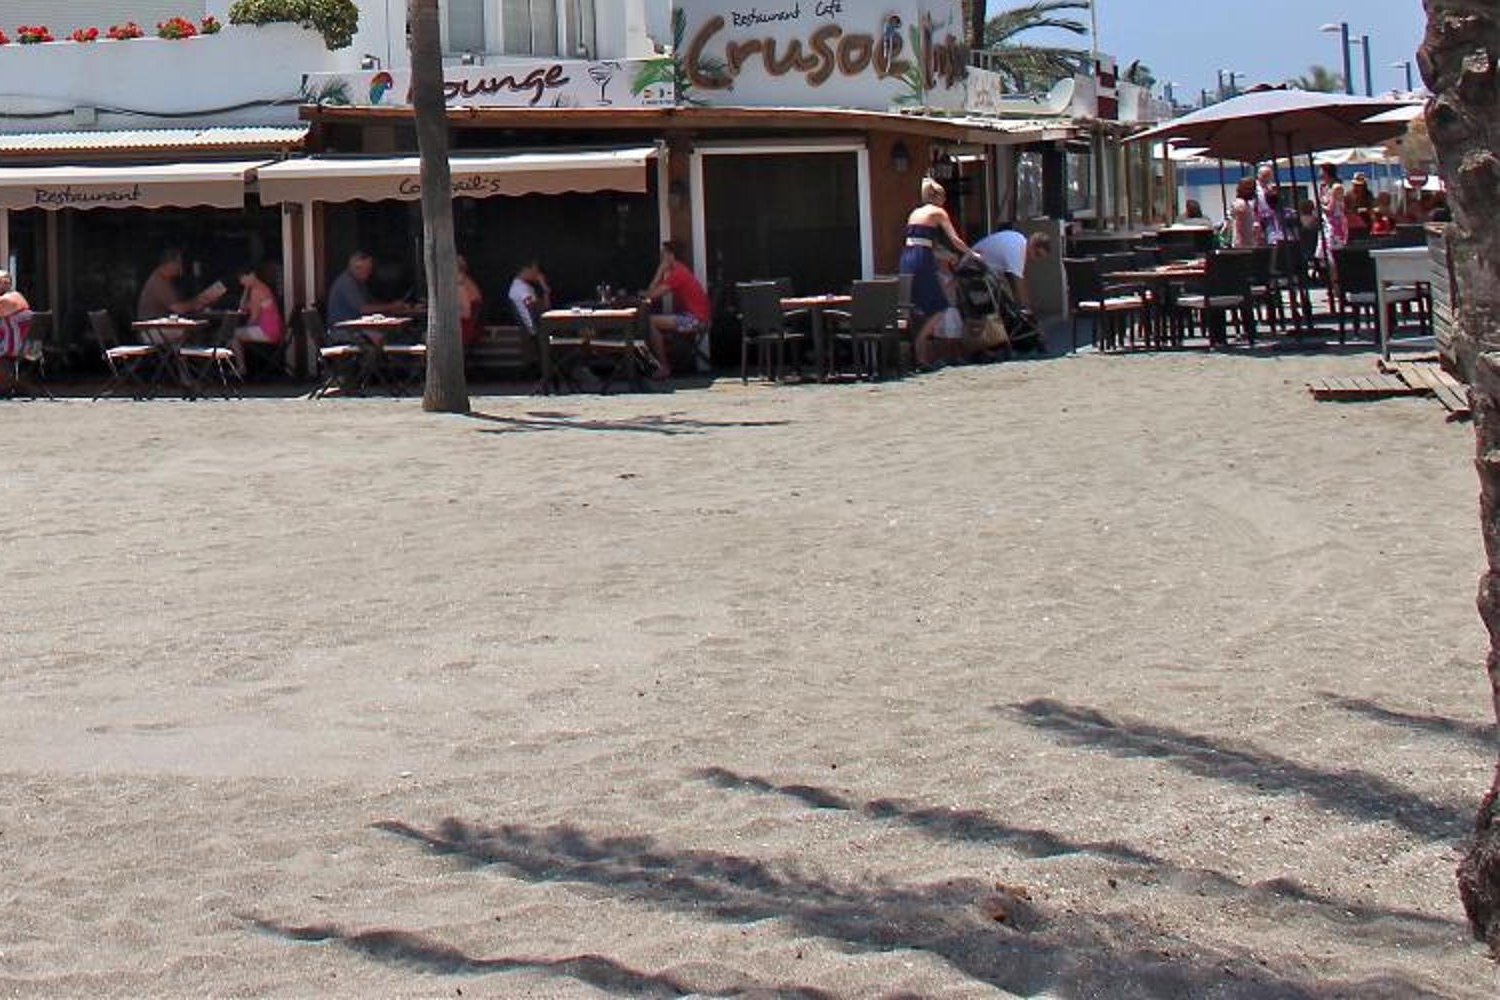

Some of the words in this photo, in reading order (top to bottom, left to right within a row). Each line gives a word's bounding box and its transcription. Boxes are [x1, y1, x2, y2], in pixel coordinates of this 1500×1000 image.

[732, 1, 801, 28] Restaurant
[406, 63, 570, 106] ounge
[34, 183, 140, 206] Restaurant
